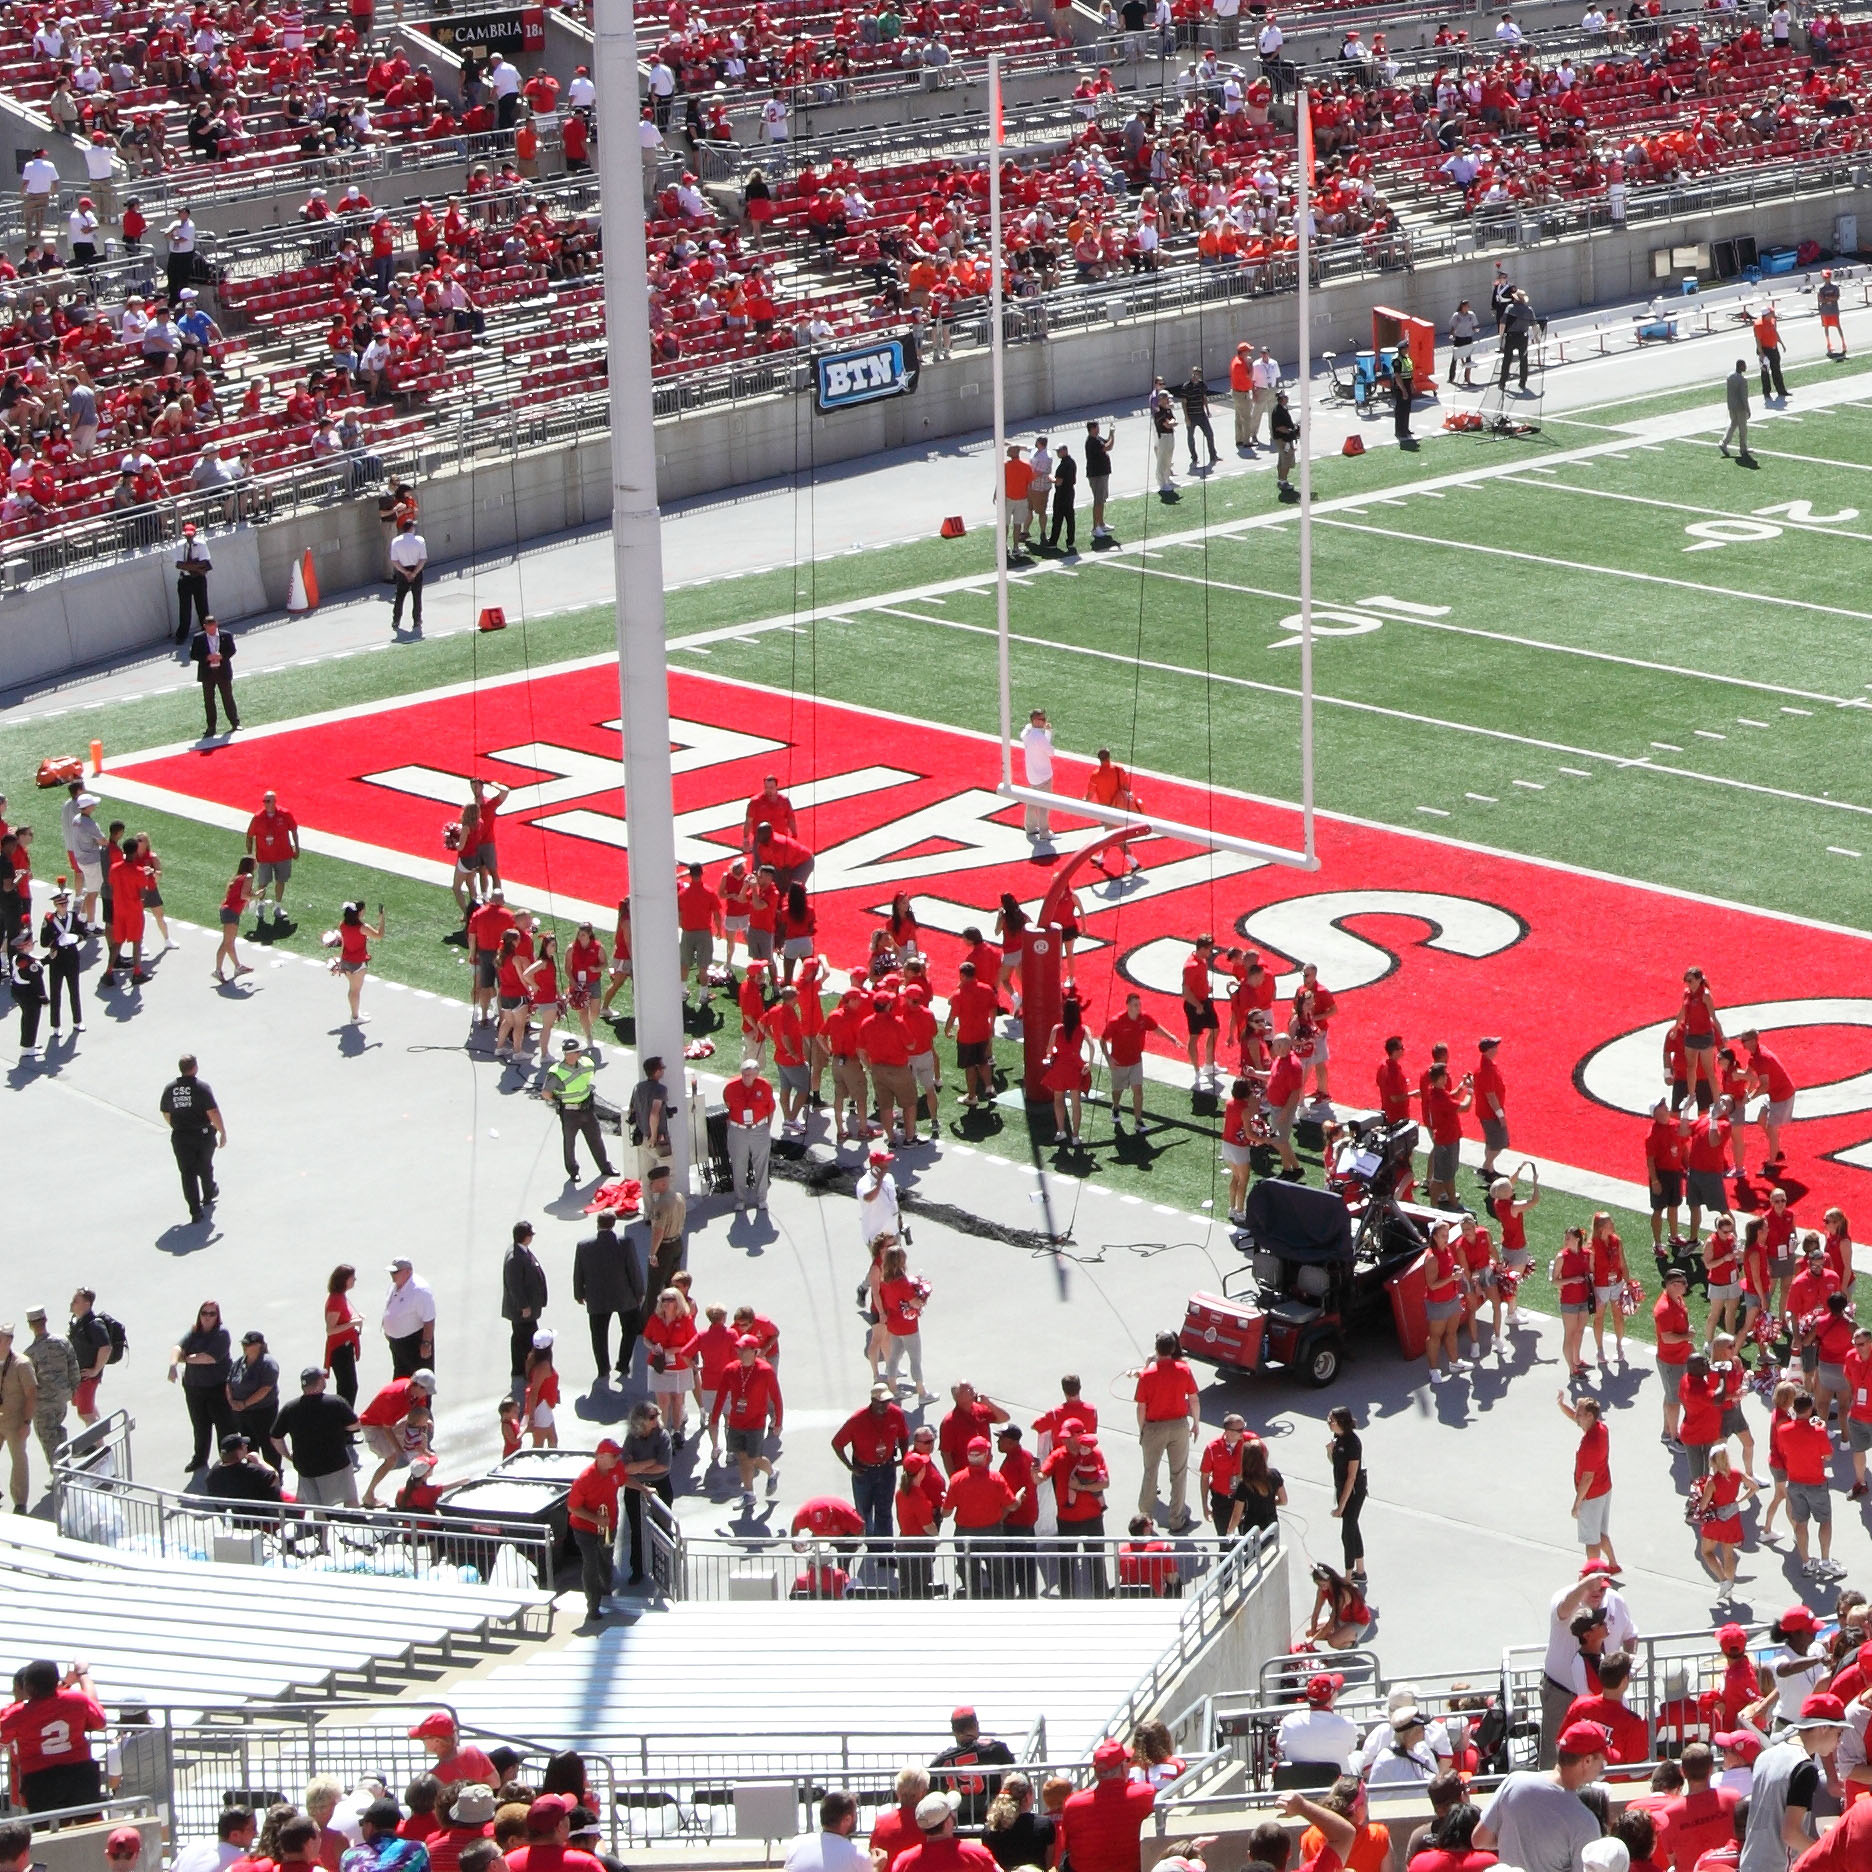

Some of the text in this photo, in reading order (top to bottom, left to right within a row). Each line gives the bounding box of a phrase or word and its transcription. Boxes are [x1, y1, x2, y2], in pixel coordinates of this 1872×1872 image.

[455, 20, 524, 44] CAMBRIA
[766, 106, 787, 124] 12
[826, 351, 894, 398] BTN
[1684, 499, 1860, 543] 20
[1279, 595, 1453, 637] 10
[352, 716, 1530, 1001] STATE
[40, 1719, 73, 1755] 2
